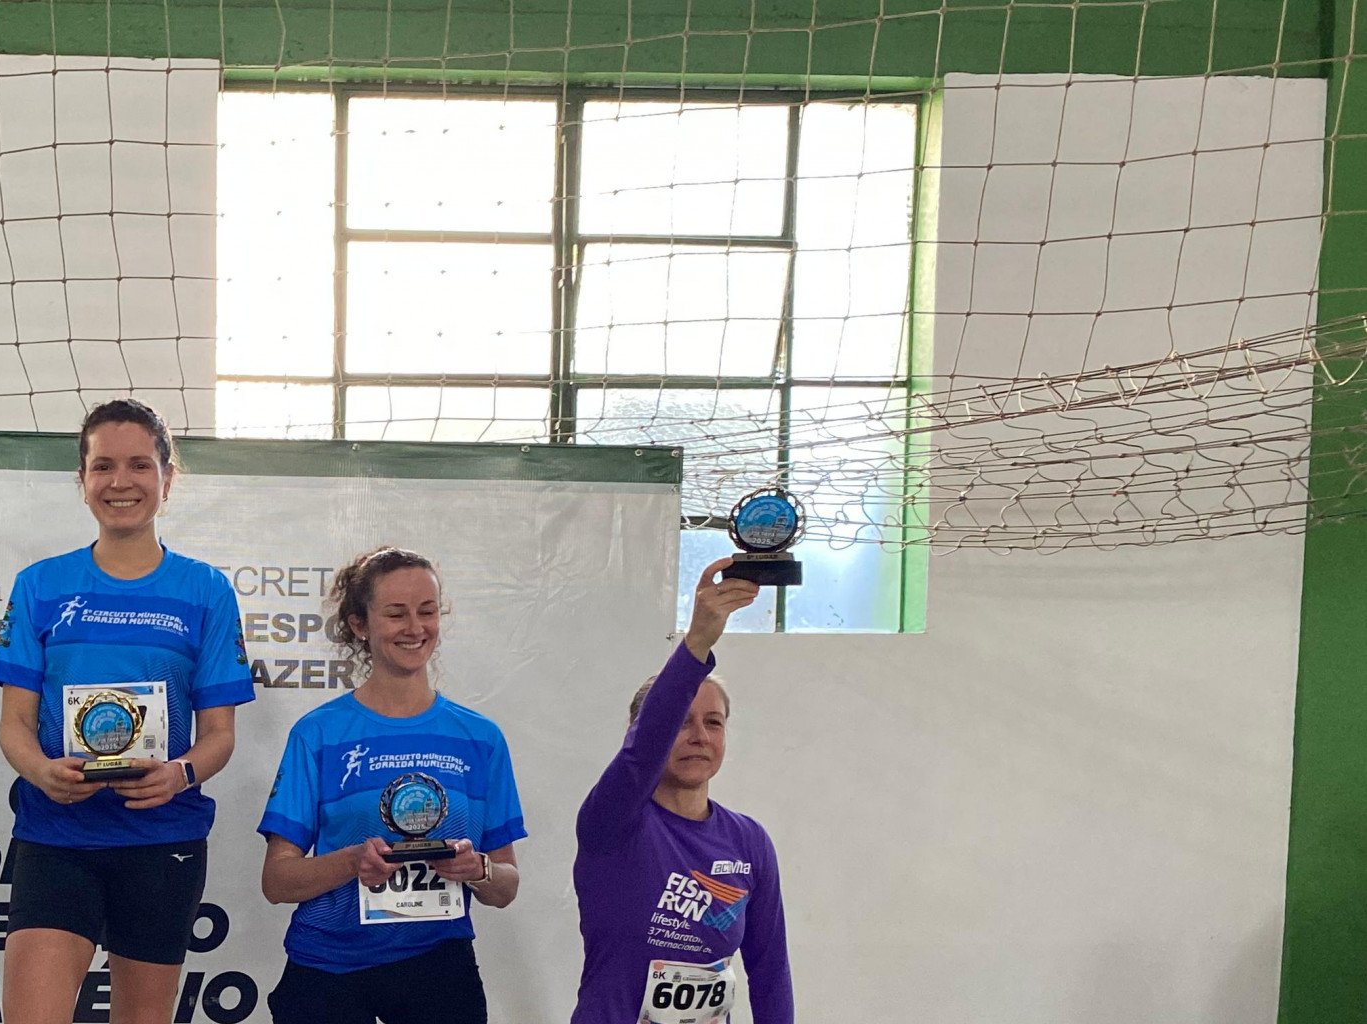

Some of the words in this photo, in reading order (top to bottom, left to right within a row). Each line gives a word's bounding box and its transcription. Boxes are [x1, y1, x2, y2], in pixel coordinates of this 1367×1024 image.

[81, 615, 127, 624] CORRIDA
[129, 618, 184, 632] MUNICIPAL
[93, 610, 135, 618] CIRCUITO
[137, 611, 183, 625] MUNICIPAL
[67, 696, 80, 706] 6K
[379, 753, 421, 761] CIRCUITO
[422, 753, 464, 765] MUNICIPAL
[369, 761, 414, 771] CORRIDA
[416, 760, 464, 773] MUNICIPAL
[657, 890, 708, 922] RUN
[652, 971, 666, 980] 6K
[652, 981, 727, 1011] 6078
